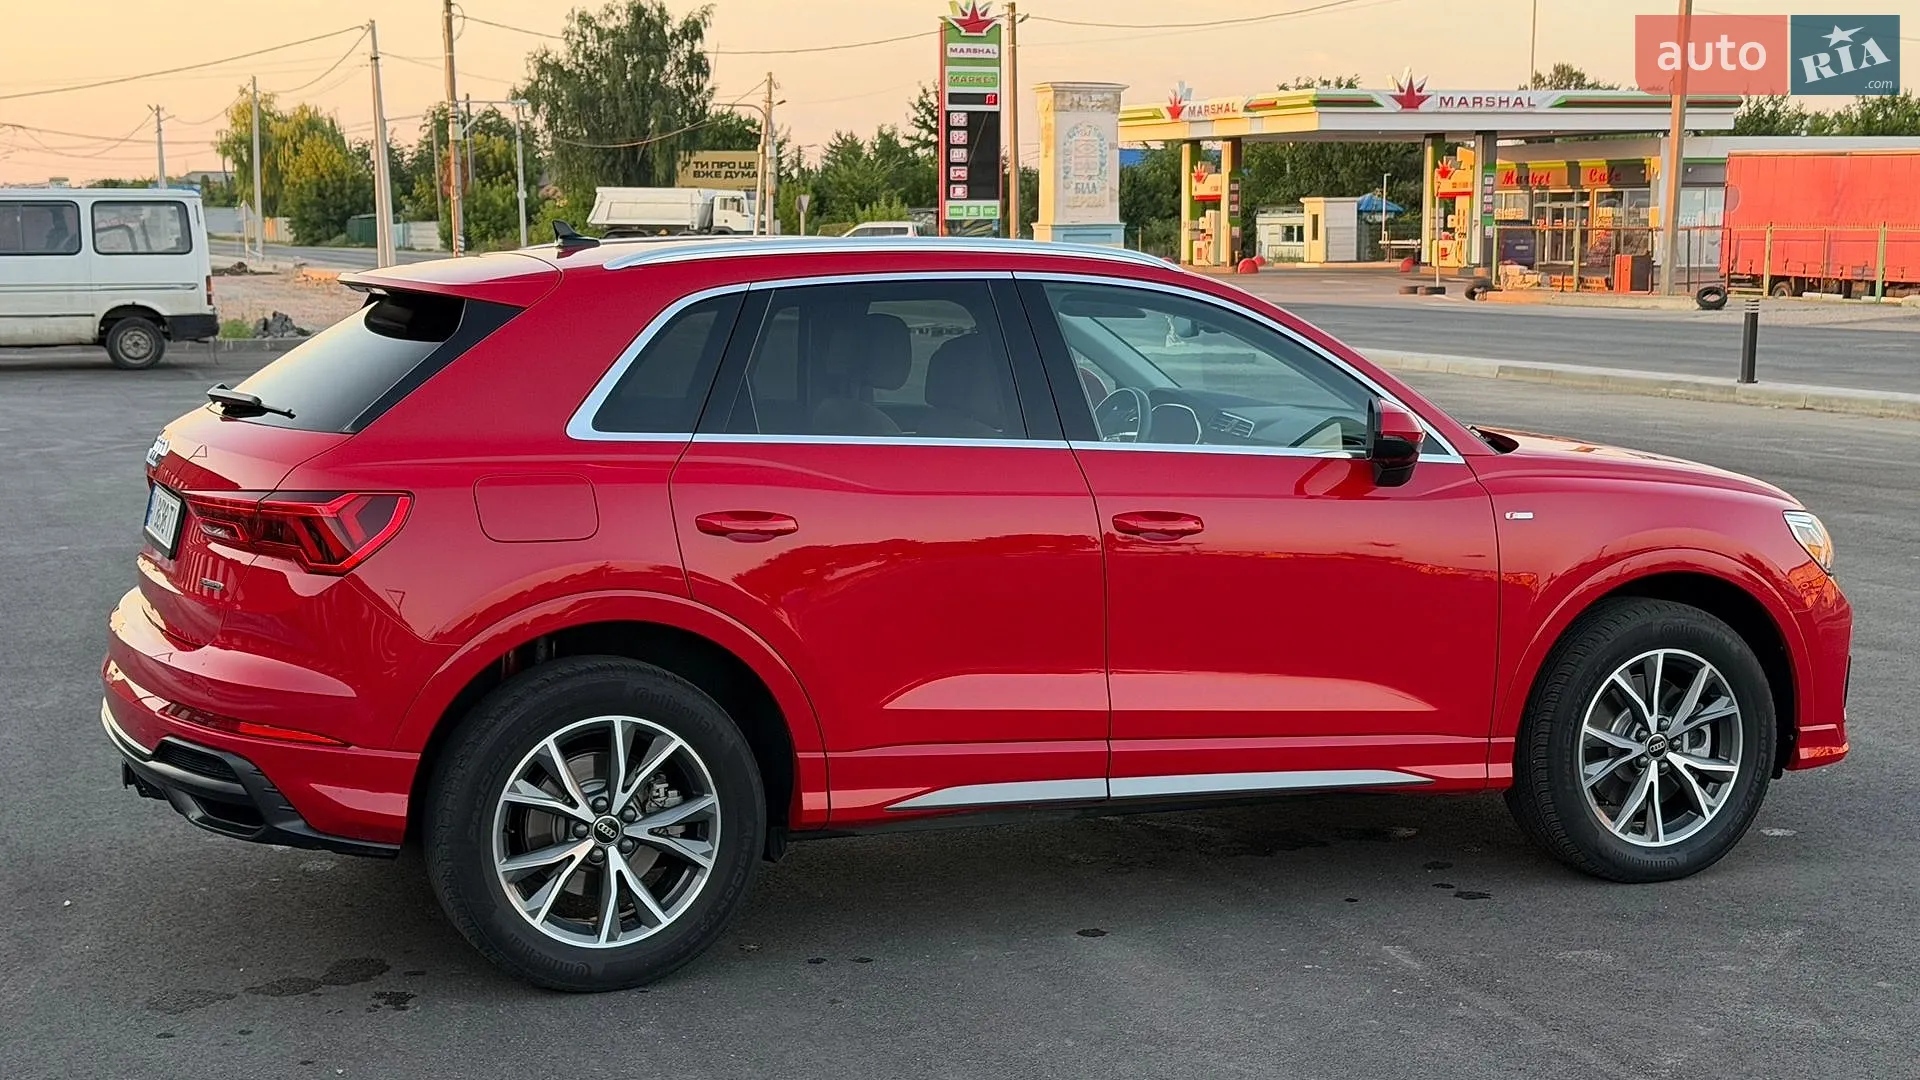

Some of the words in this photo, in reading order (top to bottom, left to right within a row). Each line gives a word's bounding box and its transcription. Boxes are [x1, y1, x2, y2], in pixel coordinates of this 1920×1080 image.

[950, 47, 997, 55] MARSHAL
[950, 76, 996, 84] MARKET
[1440, 95, 1537, 108] MARSHAL
[1187, 102, 1237, 118] MARSHAL
[693, 161, 709, 169] ТИ
[711, 161, 737, 169] ПРО
[739, 161, 756, 170] ЦЕ
[693, 170, 722, 179] ВЖЕ
[723, 170, 766, 180] ДУМА
[1502, 169, 1551, 186] Market
[1588, 167, 1622, 183] Cafe
